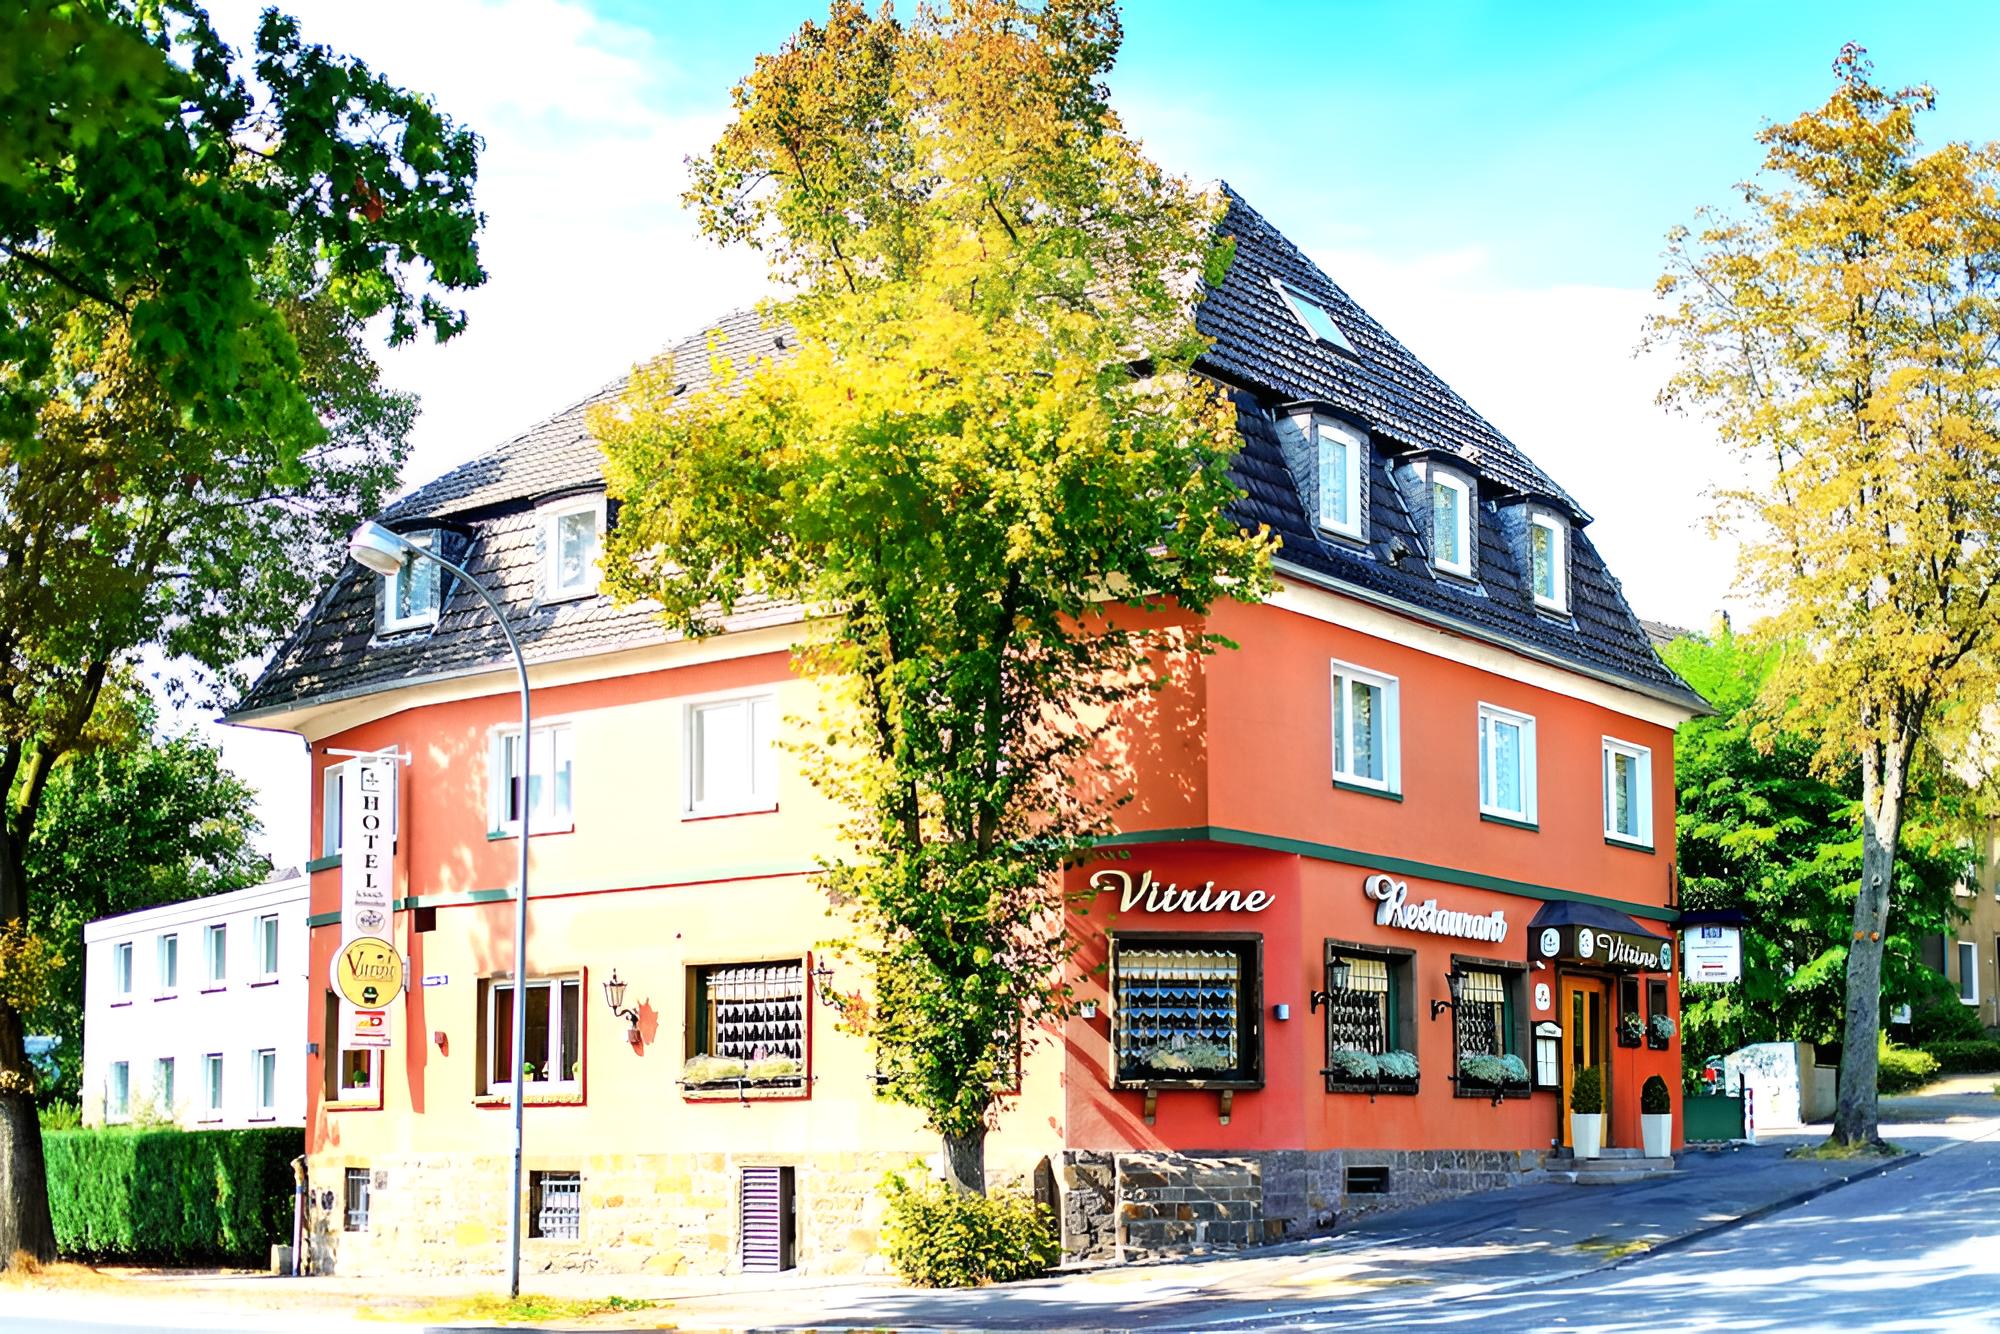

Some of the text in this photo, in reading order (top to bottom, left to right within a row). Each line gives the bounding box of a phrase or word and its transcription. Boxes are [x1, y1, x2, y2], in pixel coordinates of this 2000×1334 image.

[362, 796, 380, 889] HOTEL
[1090, 869, 1275, 912] Vitrine
[1366, 874, 1508, 943] Restaurant
[1596, 934, 1658, 969] Vitrine
